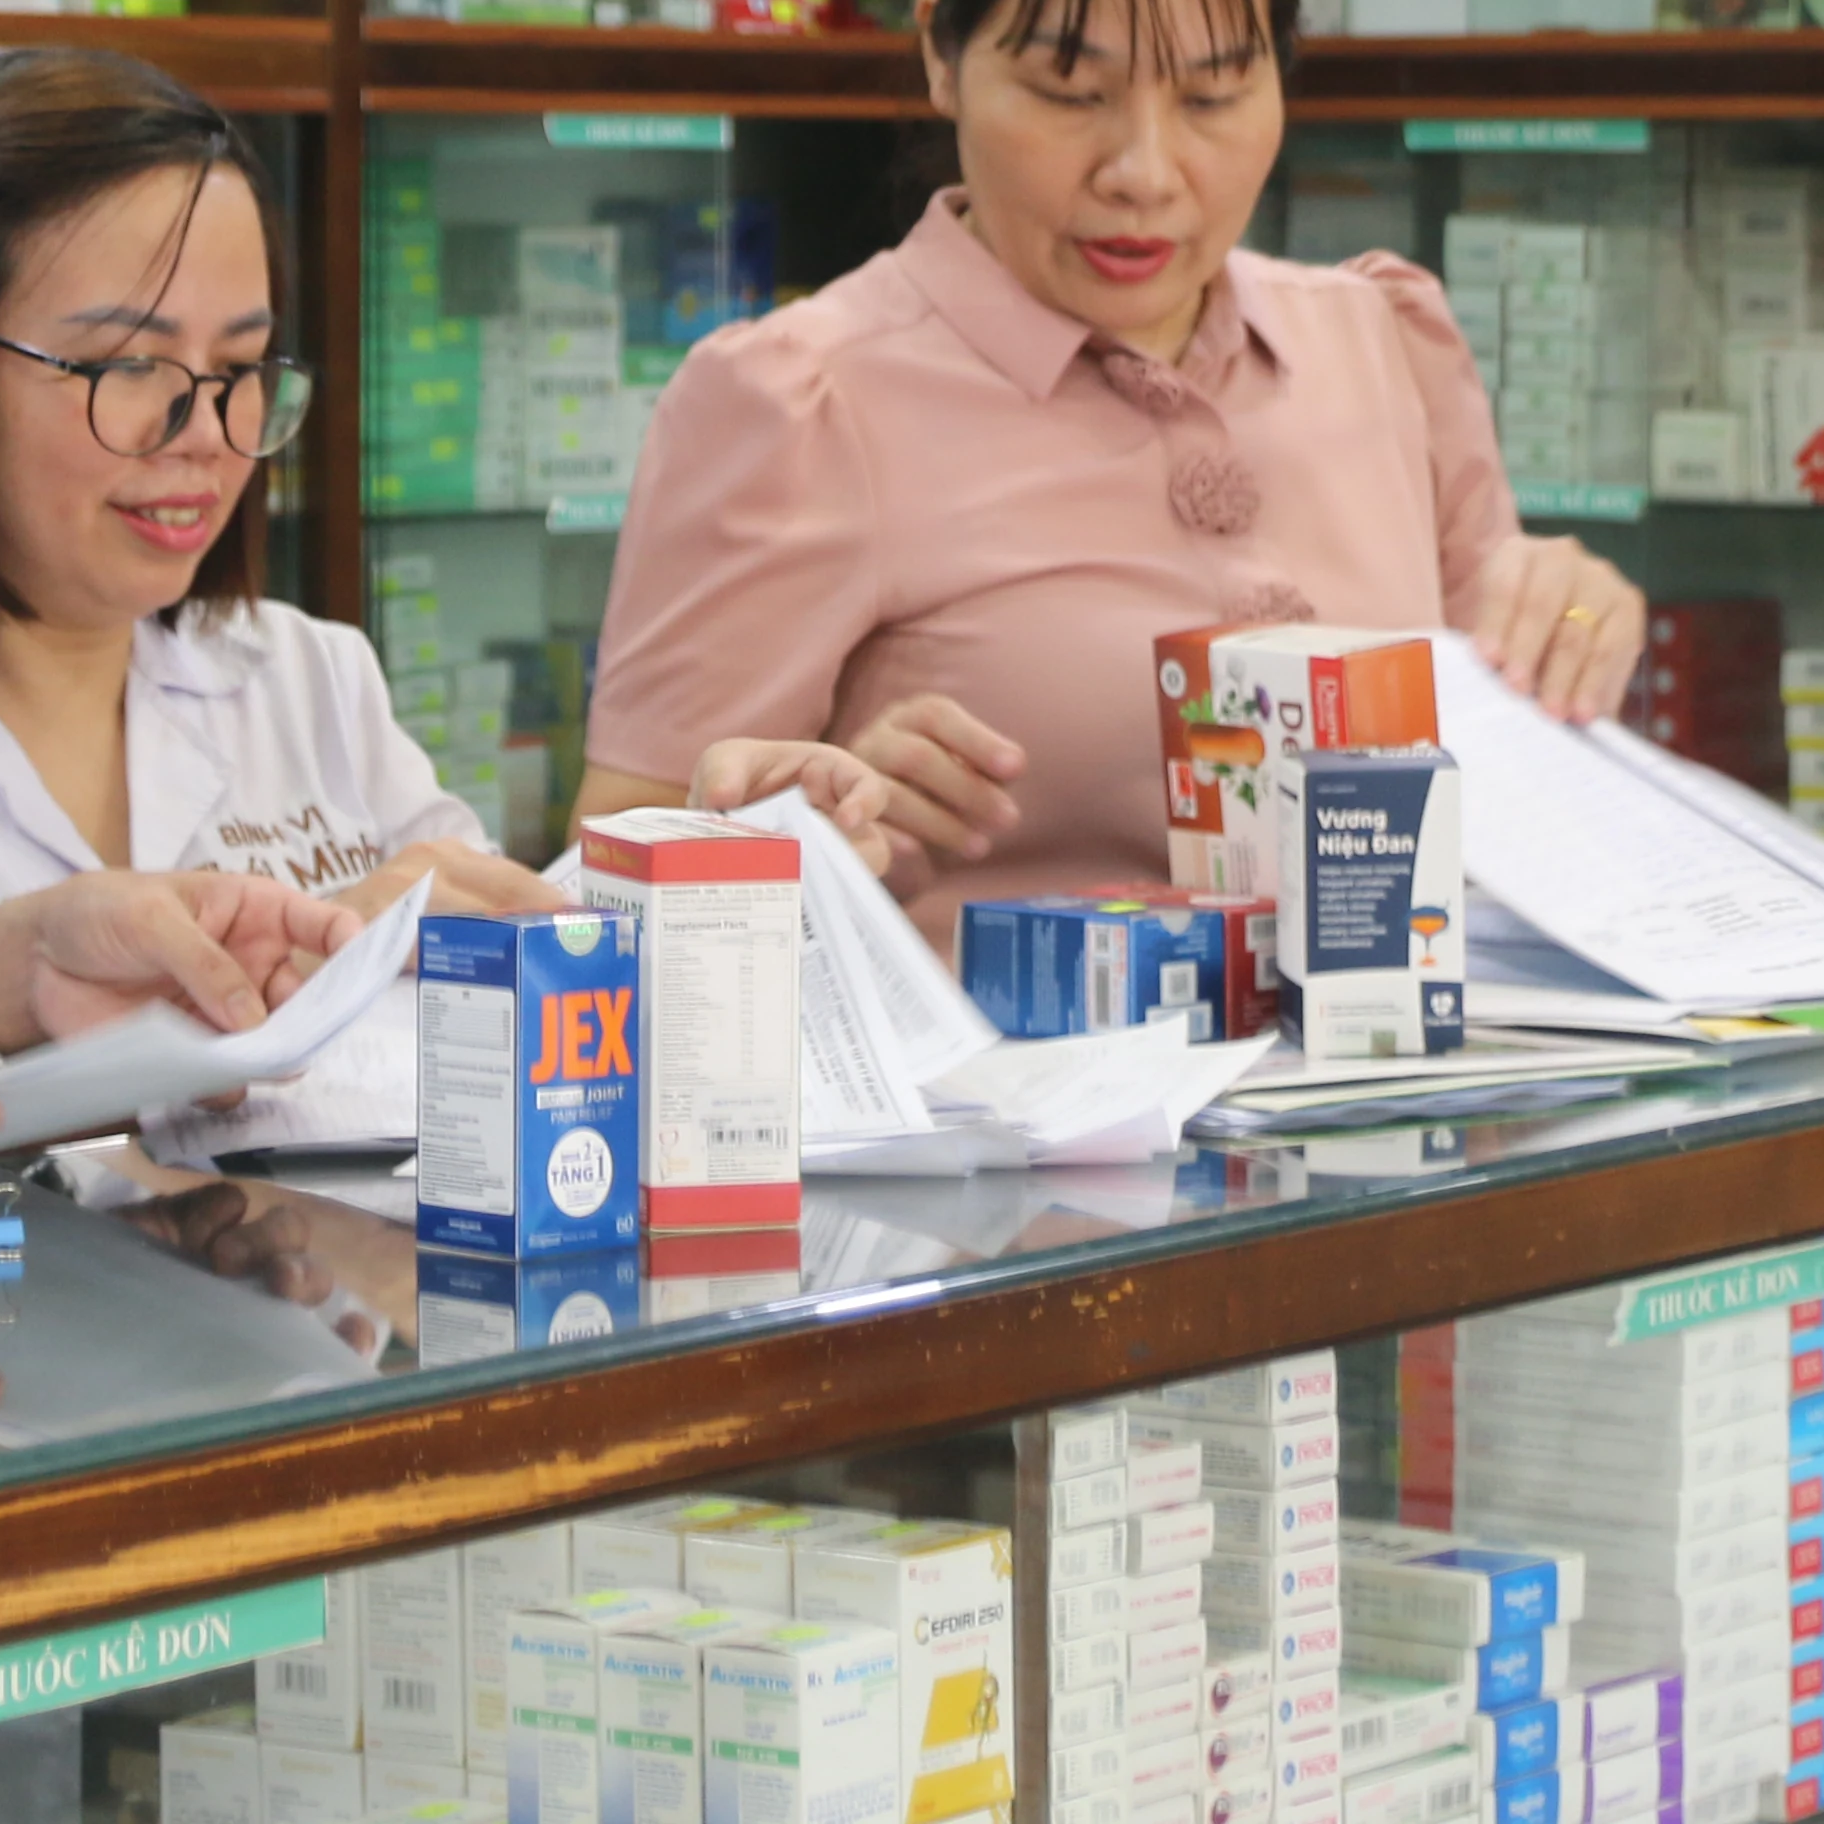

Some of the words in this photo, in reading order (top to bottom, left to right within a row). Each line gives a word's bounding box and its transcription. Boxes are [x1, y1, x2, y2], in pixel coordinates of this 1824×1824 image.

[1316, 807, 1388, 835] Vương
[1318, 833, 1369, 861] Niệu
[1372, 833, 1415, 856] Đan
[529, 986, 634, 1085] JEX
[587, 1084, 624, 1105] JOINT
[1646, 1278, 1719, 1327] THUỐC
[1724, 1267, 1753, 1308] KÊ
[1756, 1262, 1800, 1300] ĐƠN
[978, 1602, 1004, 1627] 250
[98, 1620, 146, 1682] KÊ
[158, 1612, 233, 1668] ĐƠN
